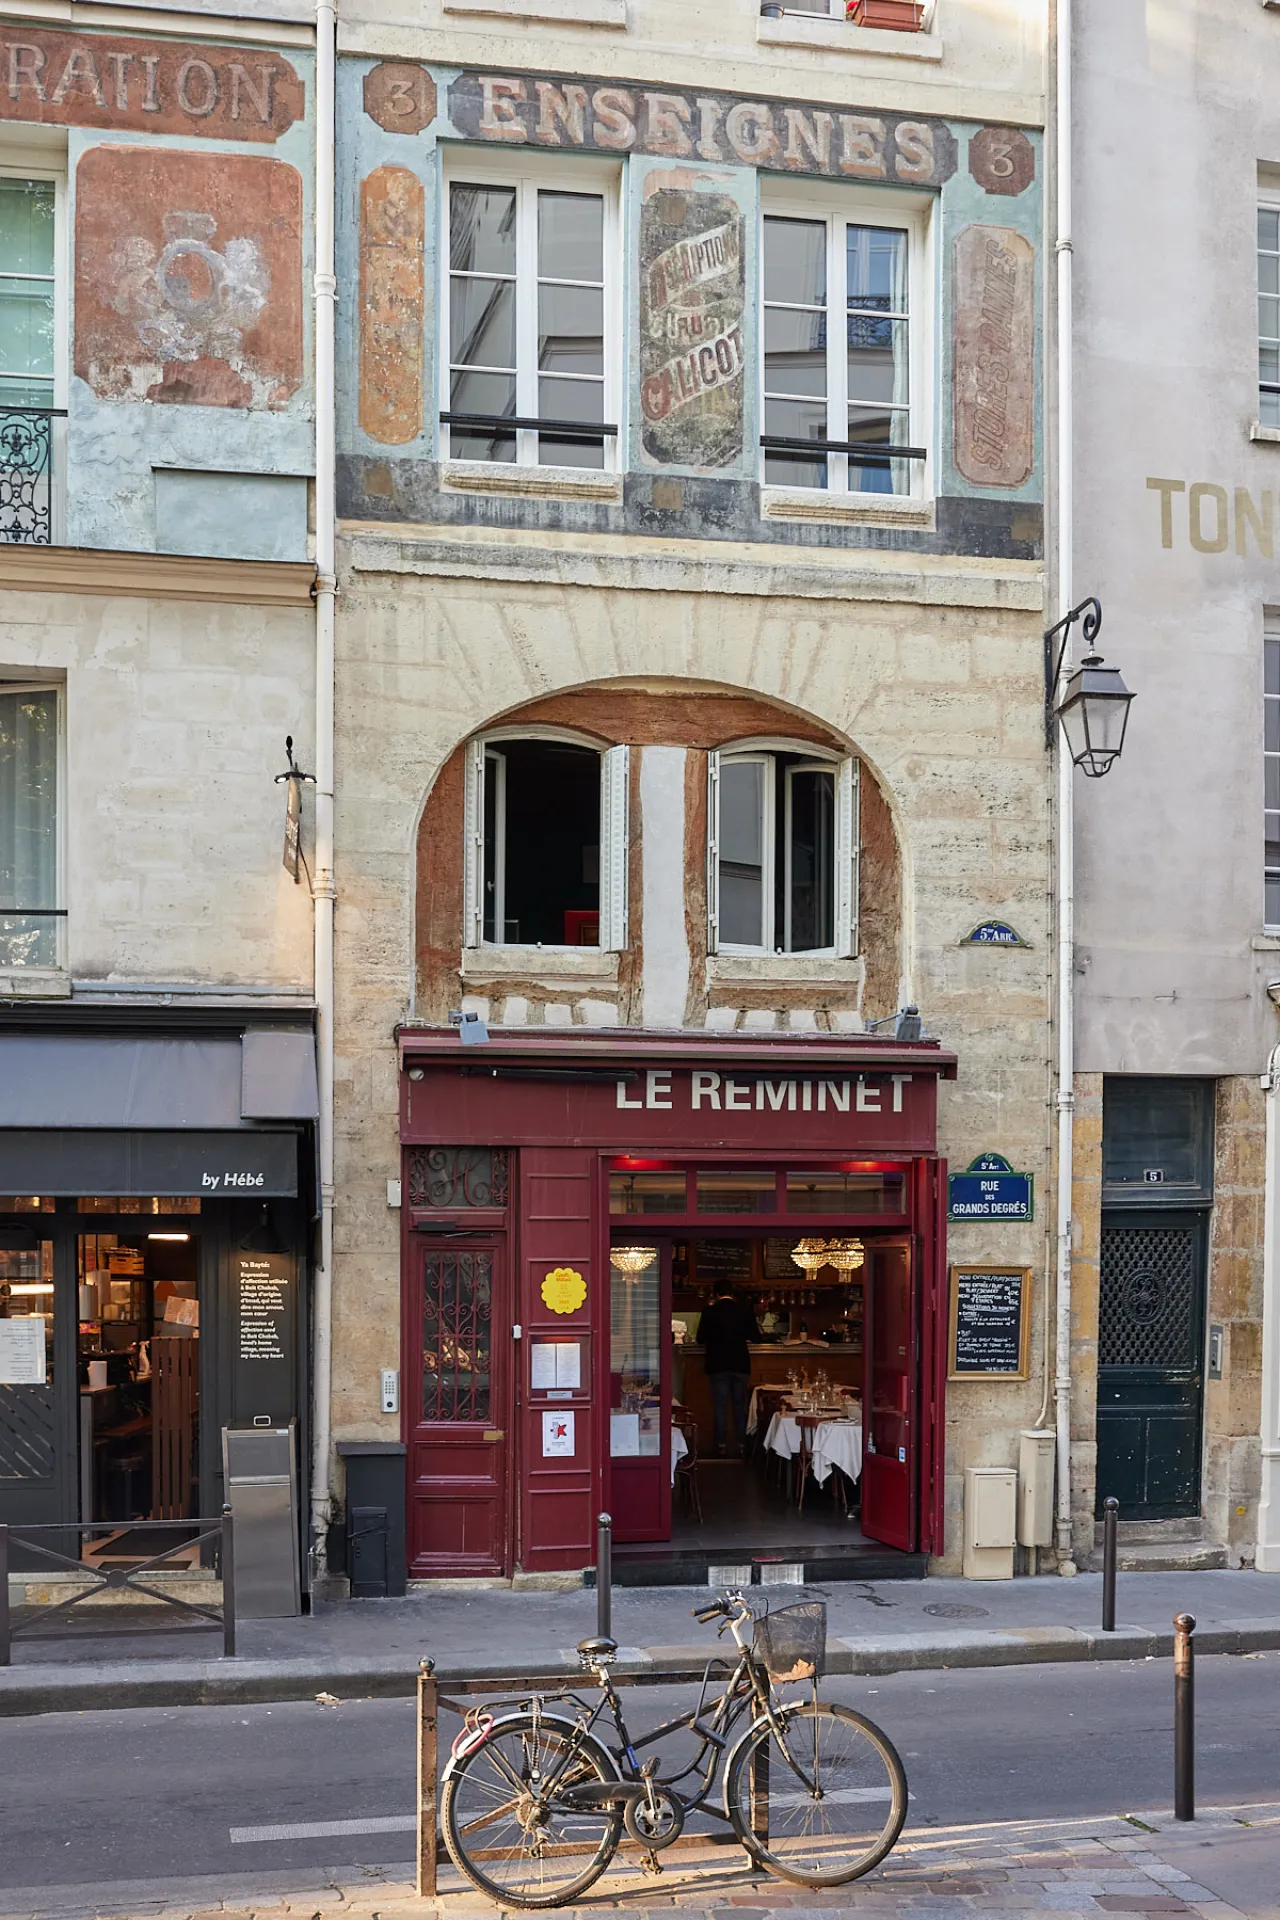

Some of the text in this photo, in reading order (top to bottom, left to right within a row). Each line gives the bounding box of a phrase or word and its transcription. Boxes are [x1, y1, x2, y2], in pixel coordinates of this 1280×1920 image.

[4, 42, 278, 123] RATION
[386, 80, 416, 116] 3
[478, 76, 936, 183] ENSEIGNES
[989, 143, 1014, 177] 3
[641, 328, 744, 421] CALICOT
[971, 238, 1019, 472] STORES BANNES
[1146, 477, 1280, 559] TON
[616, 1070, 913, 1113] LE REMINET
[201, 1172, 264, 1190] by Hébé
[981, 1180, 999, 1191] RUE
[1150, 1171, 1157, 1182] 5
[952, 1200, 1027, 1214] GRANDS DEGRÉS
